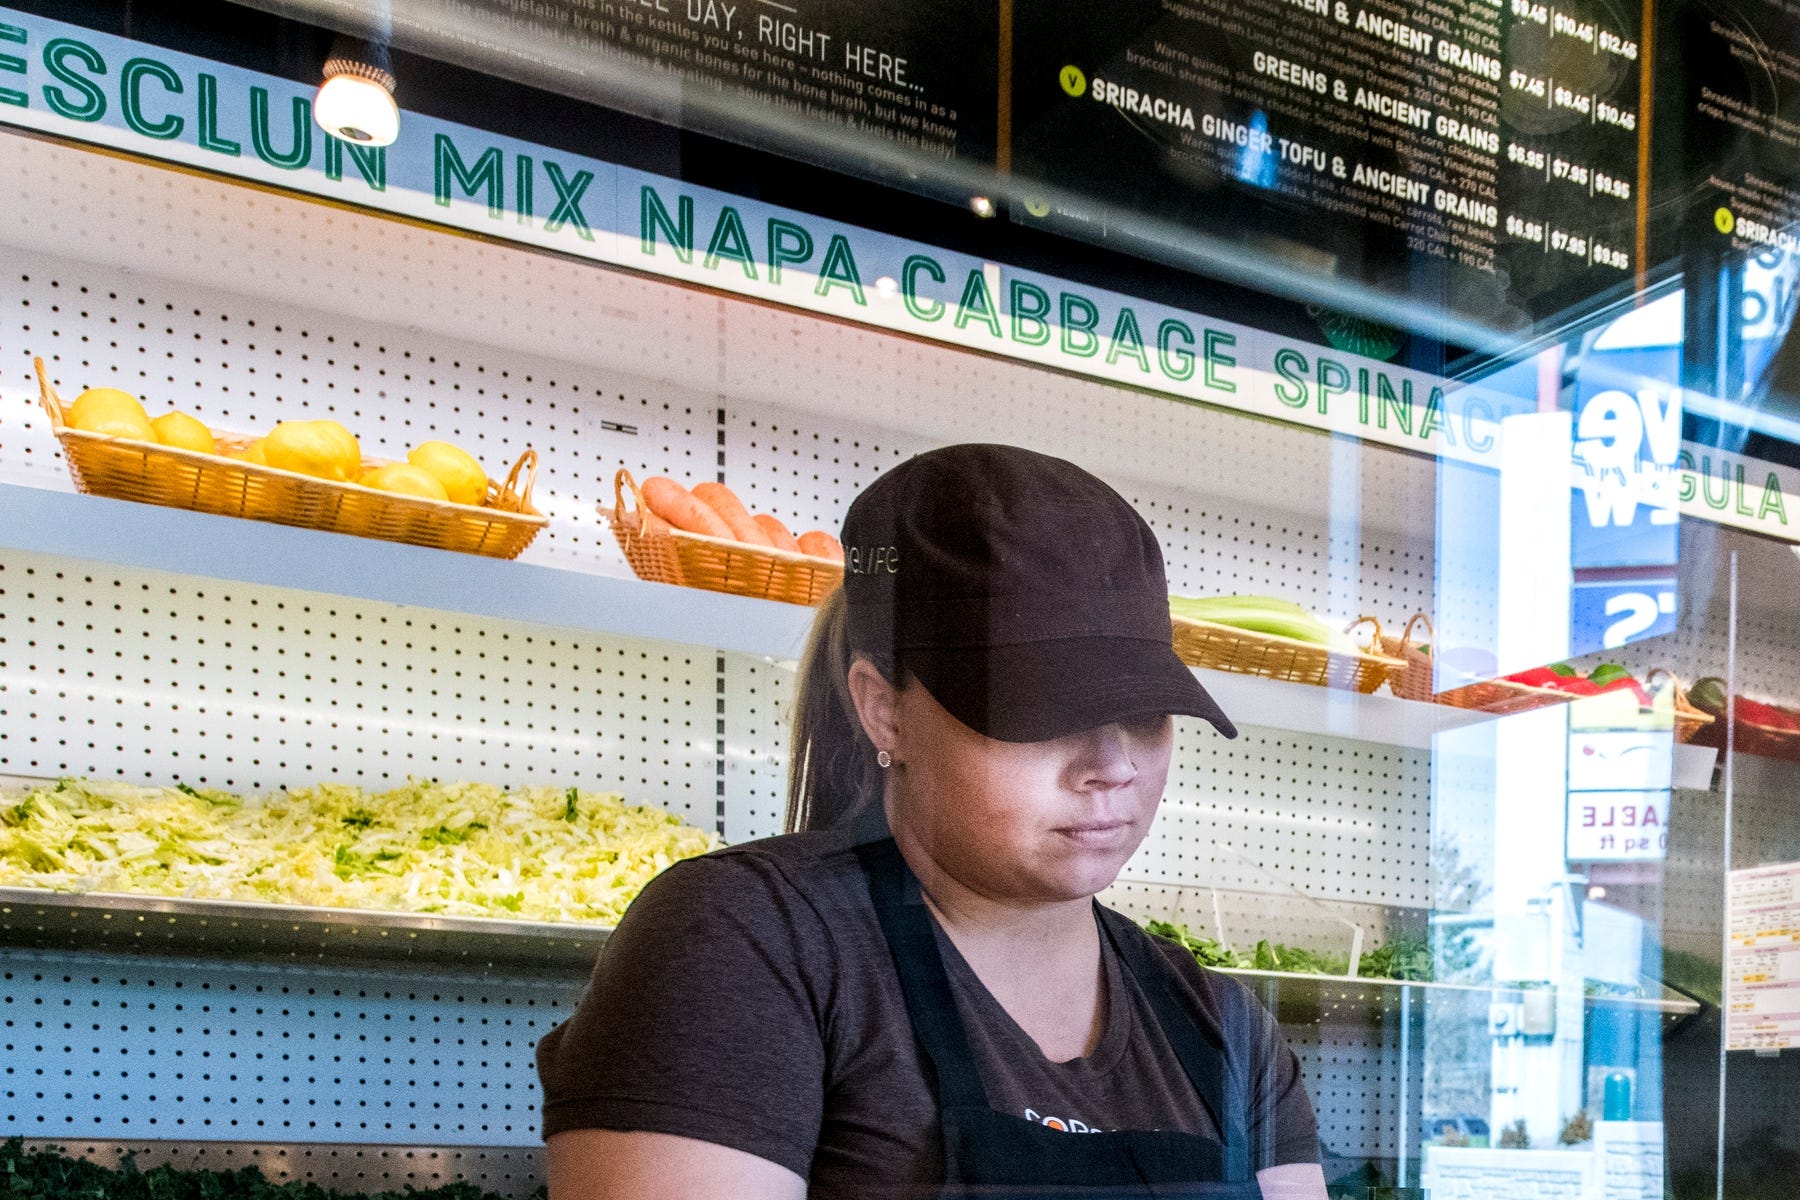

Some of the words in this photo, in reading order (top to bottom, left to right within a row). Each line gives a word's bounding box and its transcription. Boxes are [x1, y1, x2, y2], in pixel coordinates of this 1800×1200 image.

[619, 4, 643, 24] the
[648, 13, 699, 43] kettles
[703, 34, 728, 54] you
[732, 42, 759, 61] see
[763, 48, 795, 72] here
[811, 64, 862, 94] nothing
[867, 84, 910, 107] comes
[914, 95, 926, 111] in
[930, 103, 945, 117] as
[949, 109, 956, 121] a
[686, 0, 743, 40] DAY,
[758, 15, 830, 61] RIGHT
[1334, 1, 1350, 25] &
[1355, 9, 1433, 56] ANCIENT
[1437, 39, 1501, 82] GRAINS
[1599, 30, 1637, 60] $12.45
[635, 29, 691, 63] organic
[695, 47, 738, 77] bones
[742, 61, 763, 83] for
[767, 69, 789, 91] the
[793, 76, 826, 101] bone
[830, 87, 870, 117] broth,
[874, 102, 895, 122] but
[900, 112, 918, 129] we
[921, 115, 956, 141] know
[1253, 50, 1327, 94] GREENS
[1332, 79, 1348, 104] &
[1353, 87, 1432, 131] ANCIENT
[1435, 115, 1500, 155] GRAINS
[1510, 69, 1545, 97] $7.45
[1597, 101, 1635, 131] $10.45
[1092, 77, 1196, 132] SRIRACHA
[1202, 113, 1273, 155] GINGER
[1279, 137, 1326, 172] TOFU
[1331, 157, 1347, 181] &
[1352, 162, 1430, 206] ANCIENT
[1433, 188, 1498, 228] GRAINS
[1508, 143, 1544, 170] $6.95
[1553, 158, 1588, 186] $7.95
[1551, 230, 1586, 257] $7.95
[433, 132, 595, 242] MIX
[640, 185, 868, 306] NAPA
[901, 254, 1238, 393] CABBAGE
[1273, 348, 1496, 454] SPINAC
